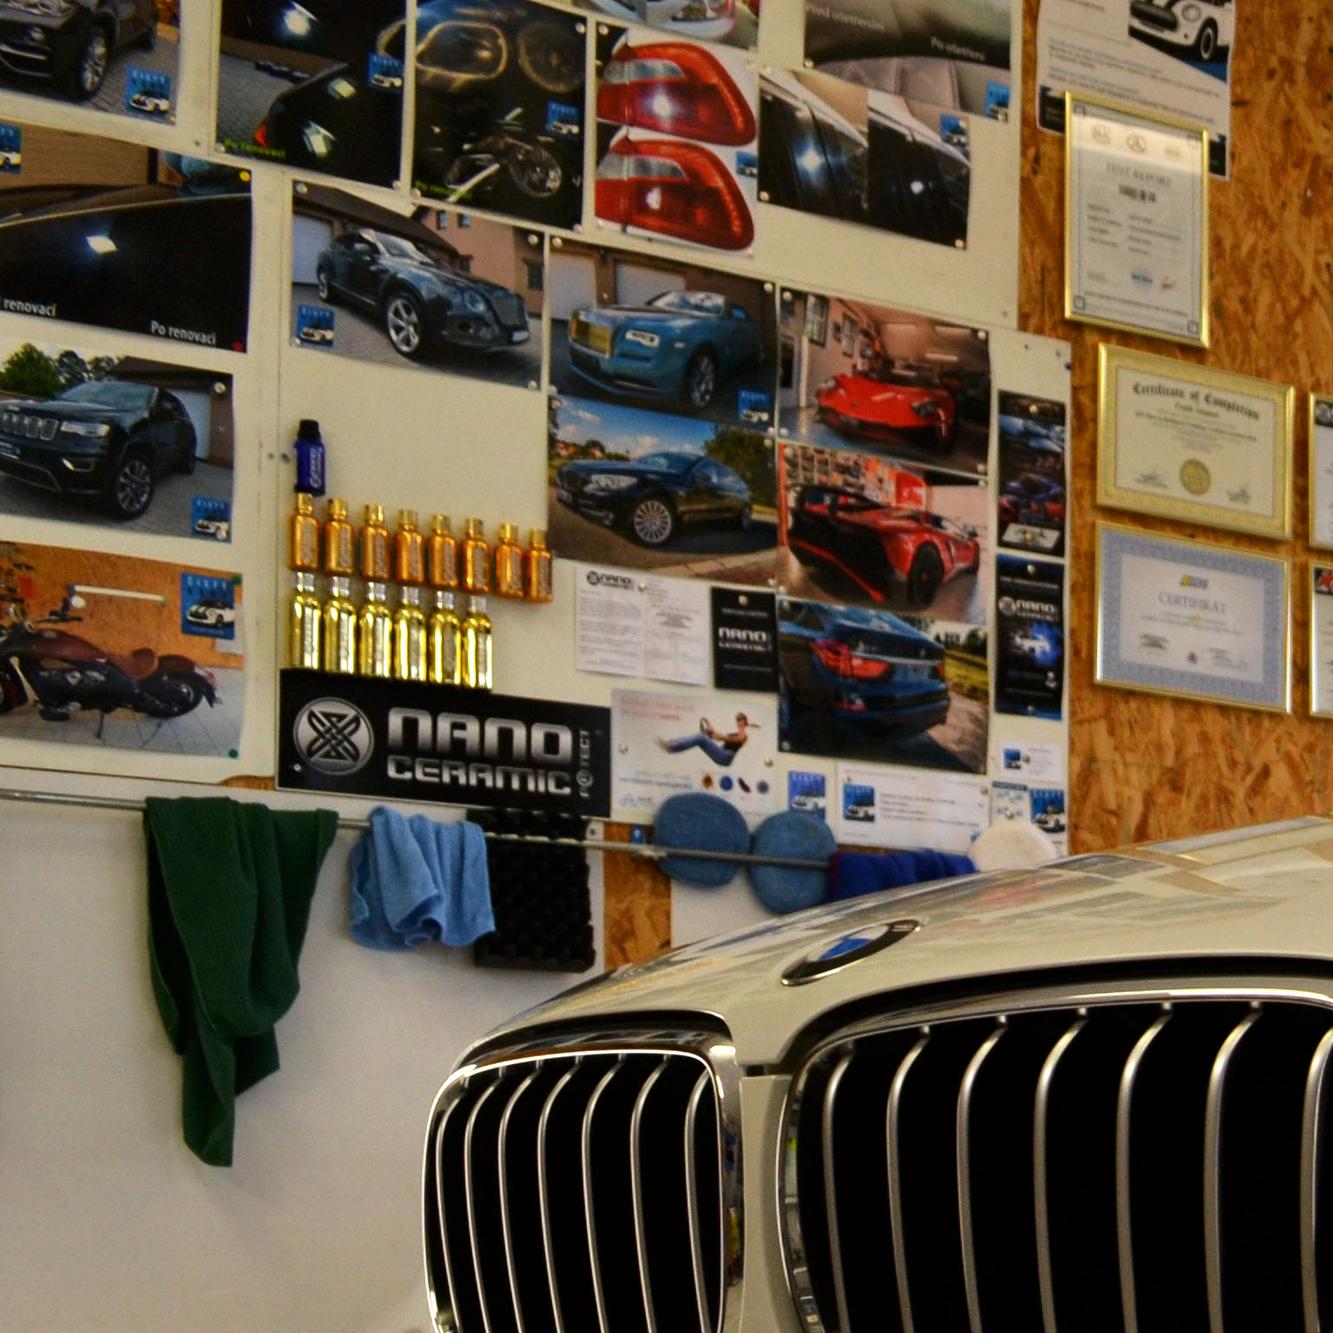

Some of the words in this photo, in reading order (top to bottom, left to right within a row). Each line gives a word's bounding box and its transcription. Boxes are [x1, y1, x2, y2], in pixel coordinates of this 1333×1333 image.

[150, 320, 166, 336] Po
[388, 706, 573, 768] NANO
[387, 754, 572, 796] CERAMIC
